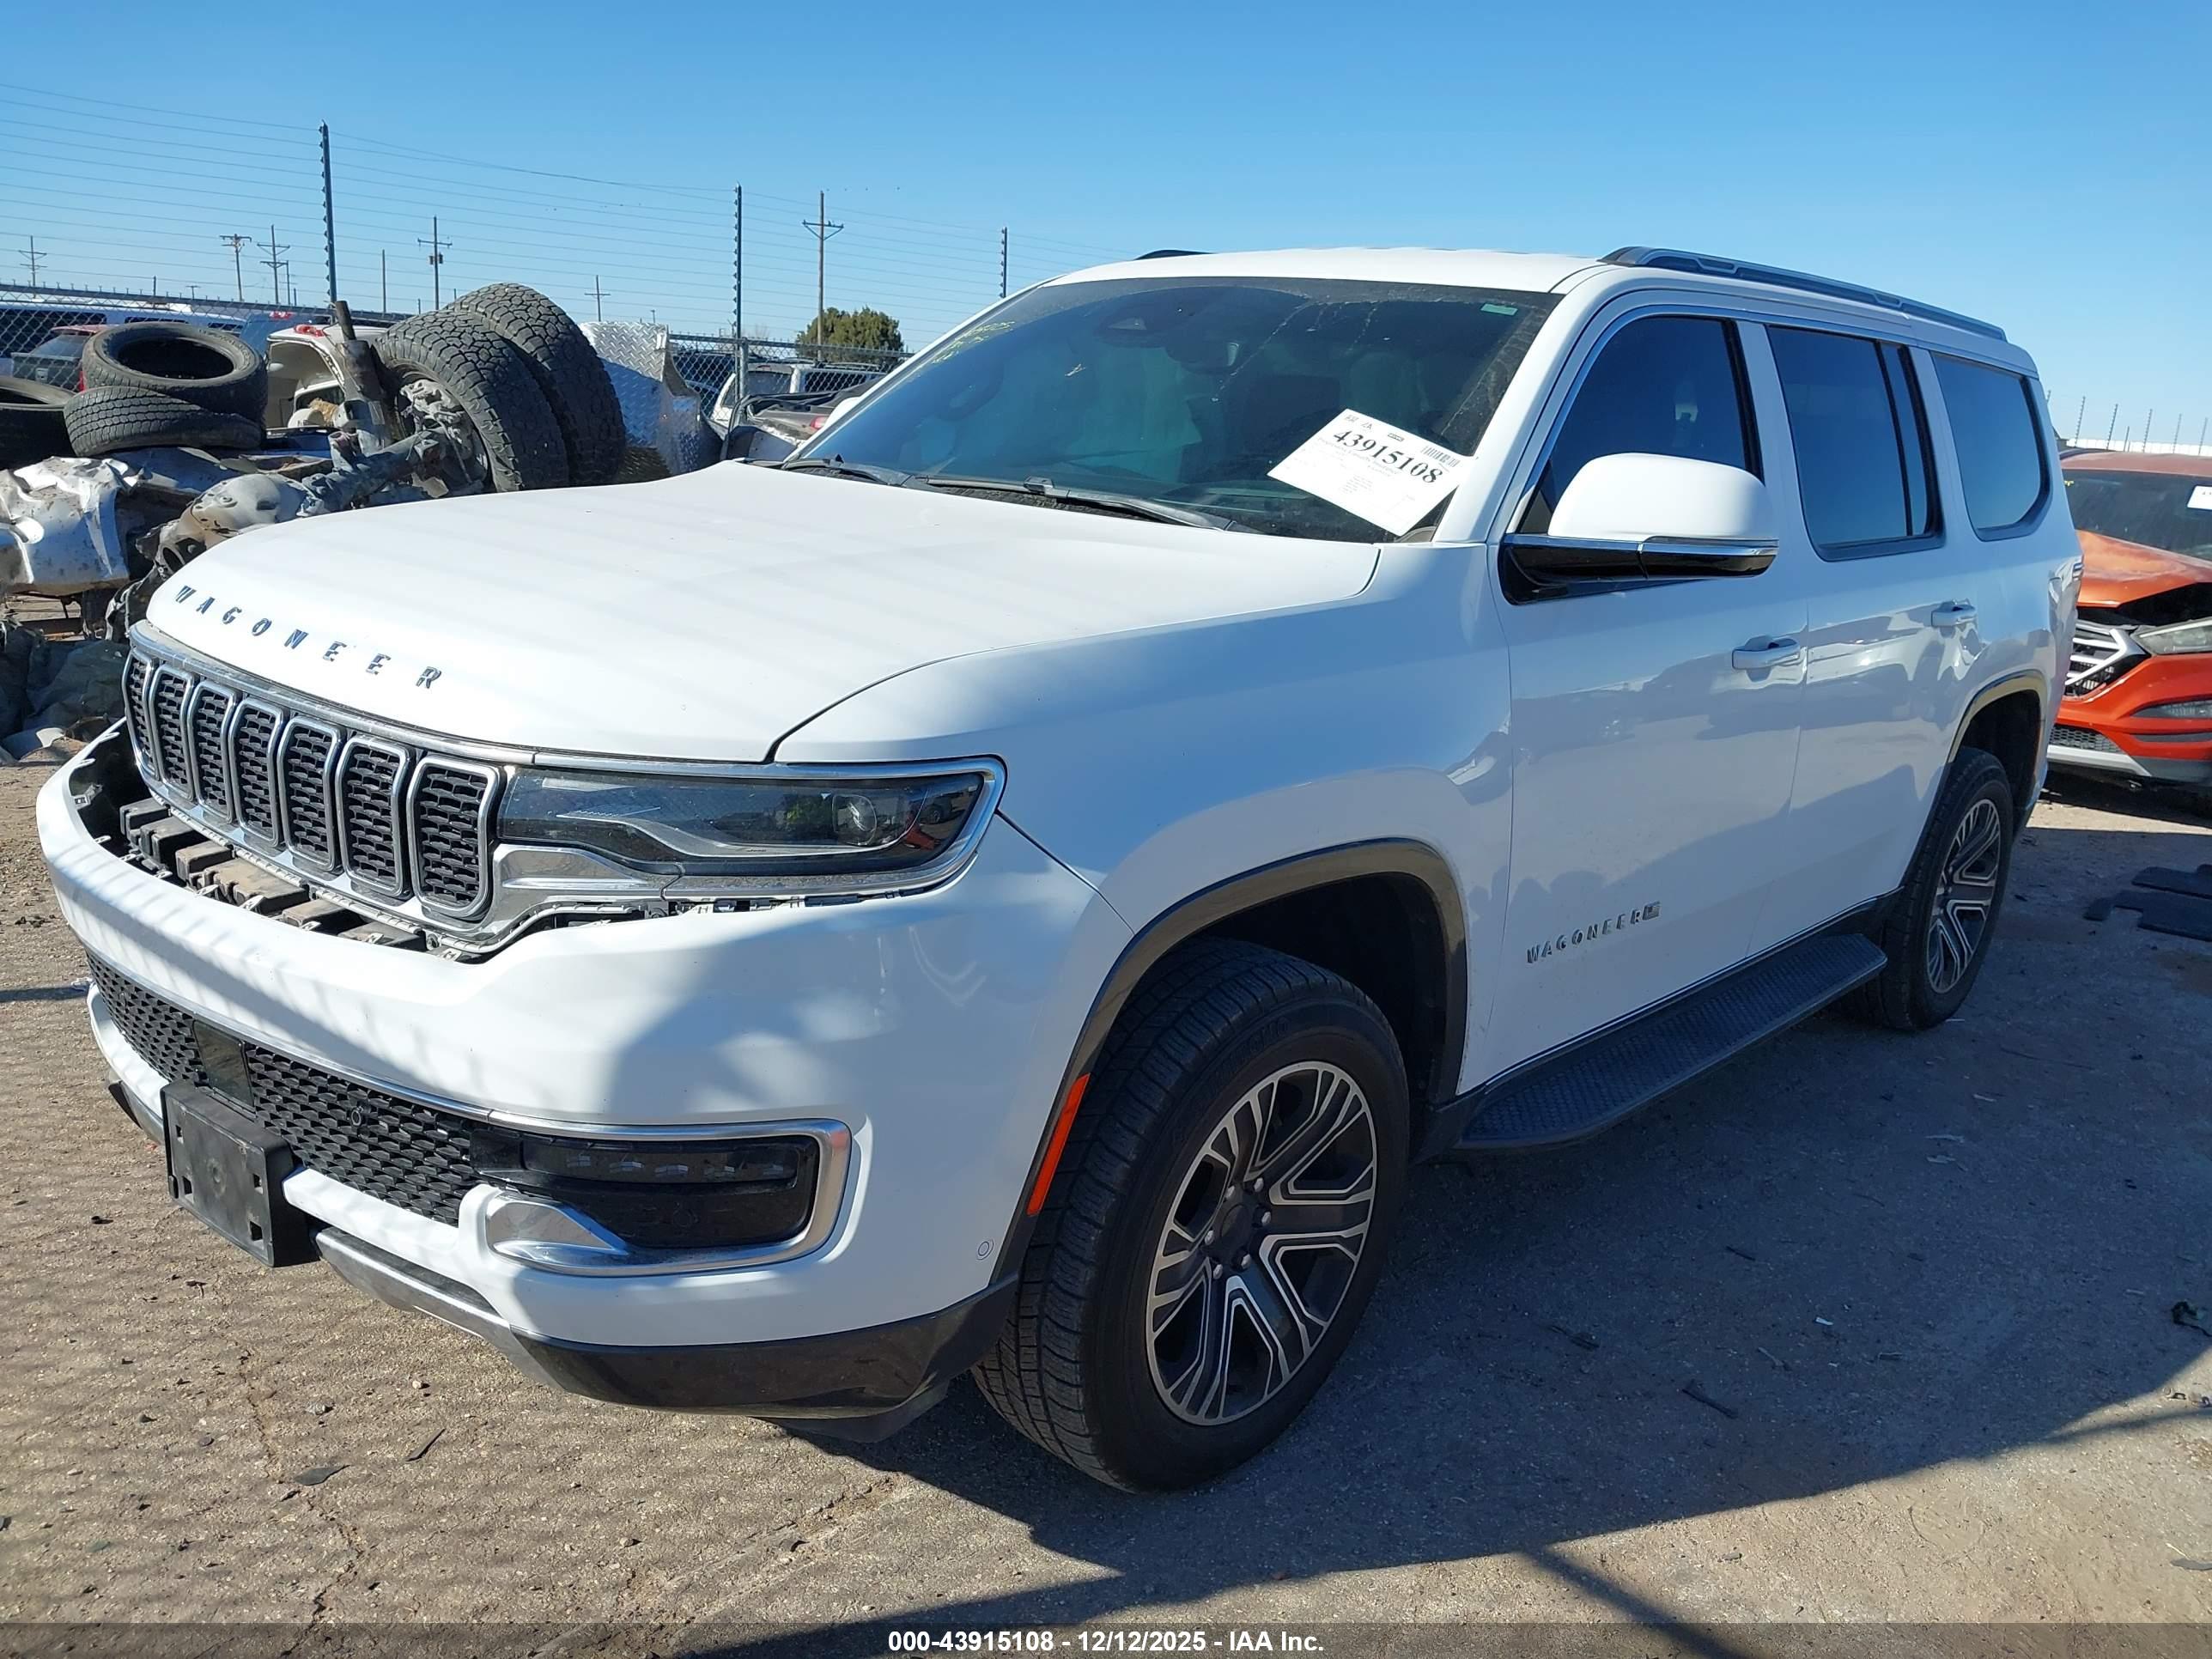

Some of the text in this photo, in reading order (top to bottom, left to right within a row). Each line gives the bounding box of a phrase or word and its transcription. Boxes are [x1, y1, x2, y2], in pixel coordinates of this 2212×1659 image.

[1333, 429, 1443, 483] 43915108
[173, 584, 443, 690] WAGONEER
[1526, 908, 1643, 964] WAGONEER
